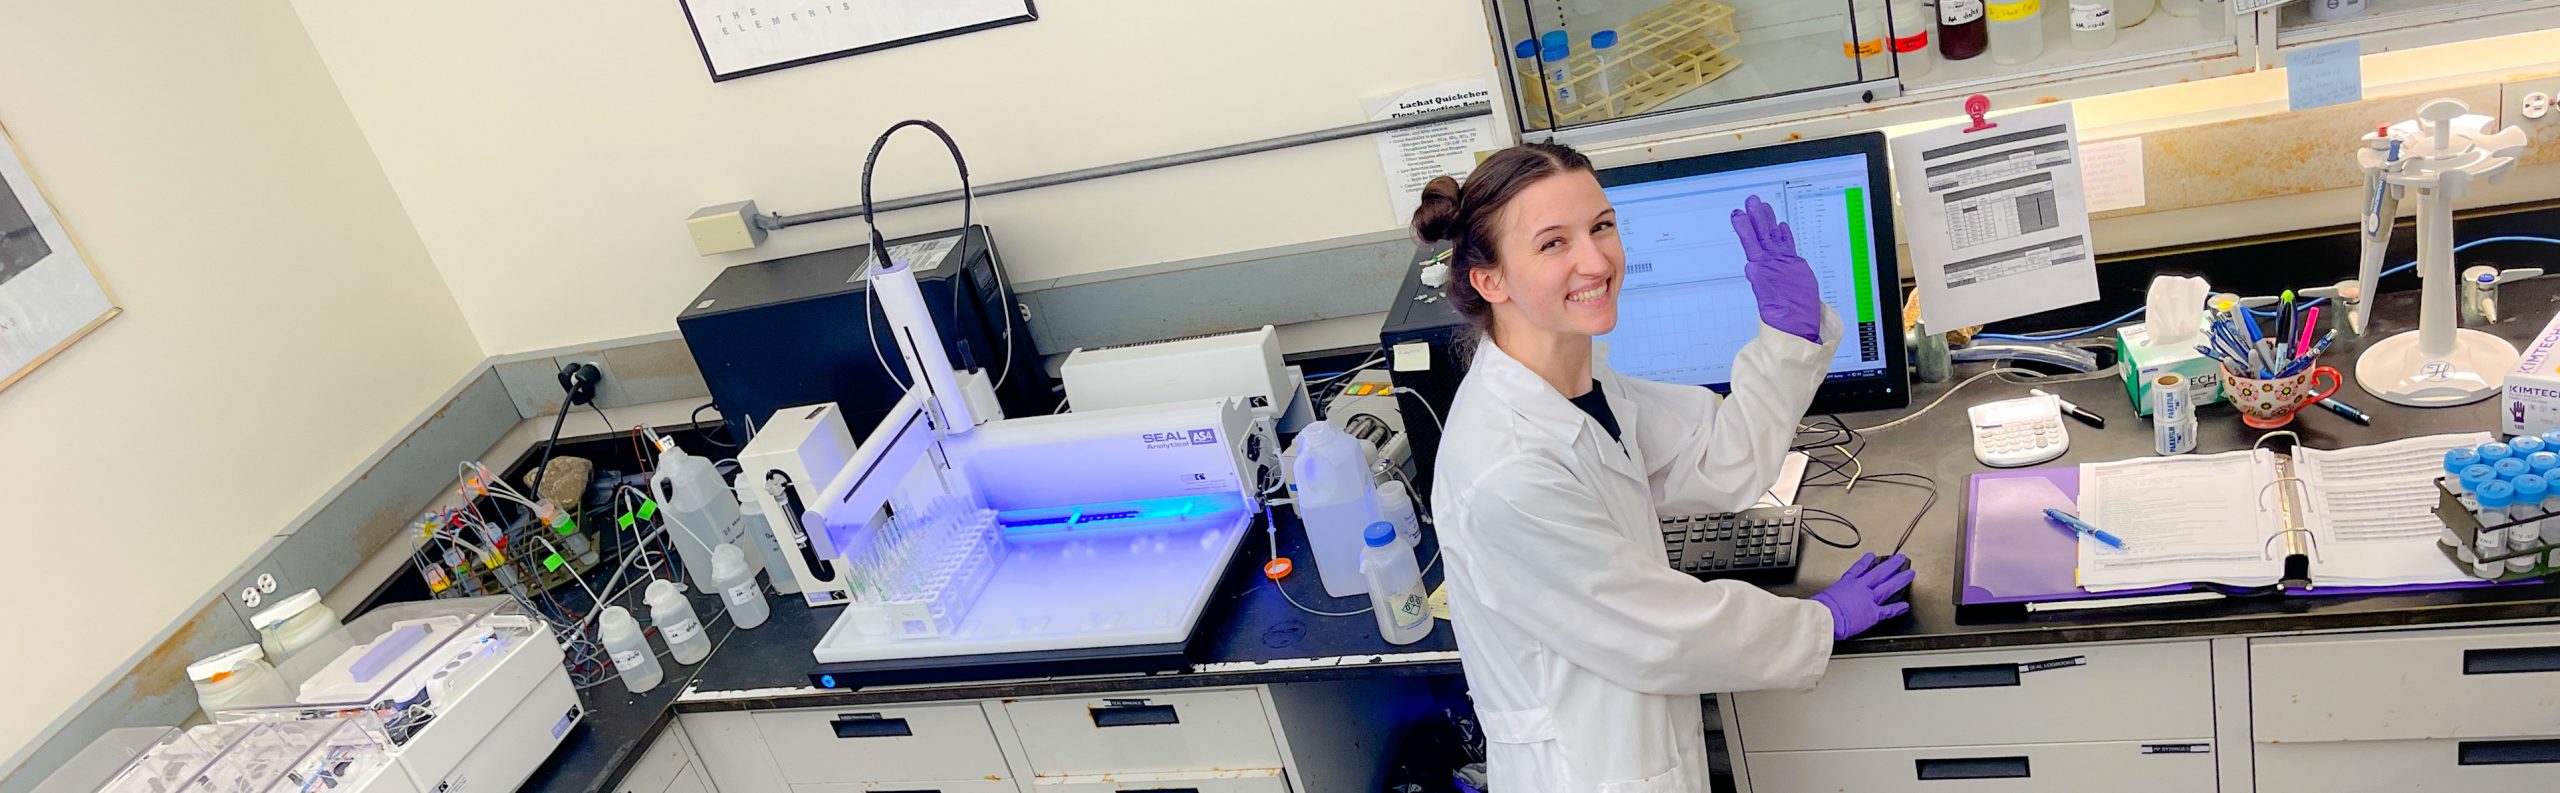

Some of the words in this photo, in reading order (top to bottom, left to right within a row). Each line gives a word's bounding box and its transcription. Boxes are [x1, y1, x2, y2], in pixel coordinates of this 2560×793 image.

[716, 7, 758, 23] THE
[721, 2, 851, 36] ELEMENTS
[1399, 98, 1433, 110] Lachat
[2189, 373, 2217, 386] ECH
[1142, 431, 1188, 443] SEAL
[1146, 441, 1190, 450] Analytical
